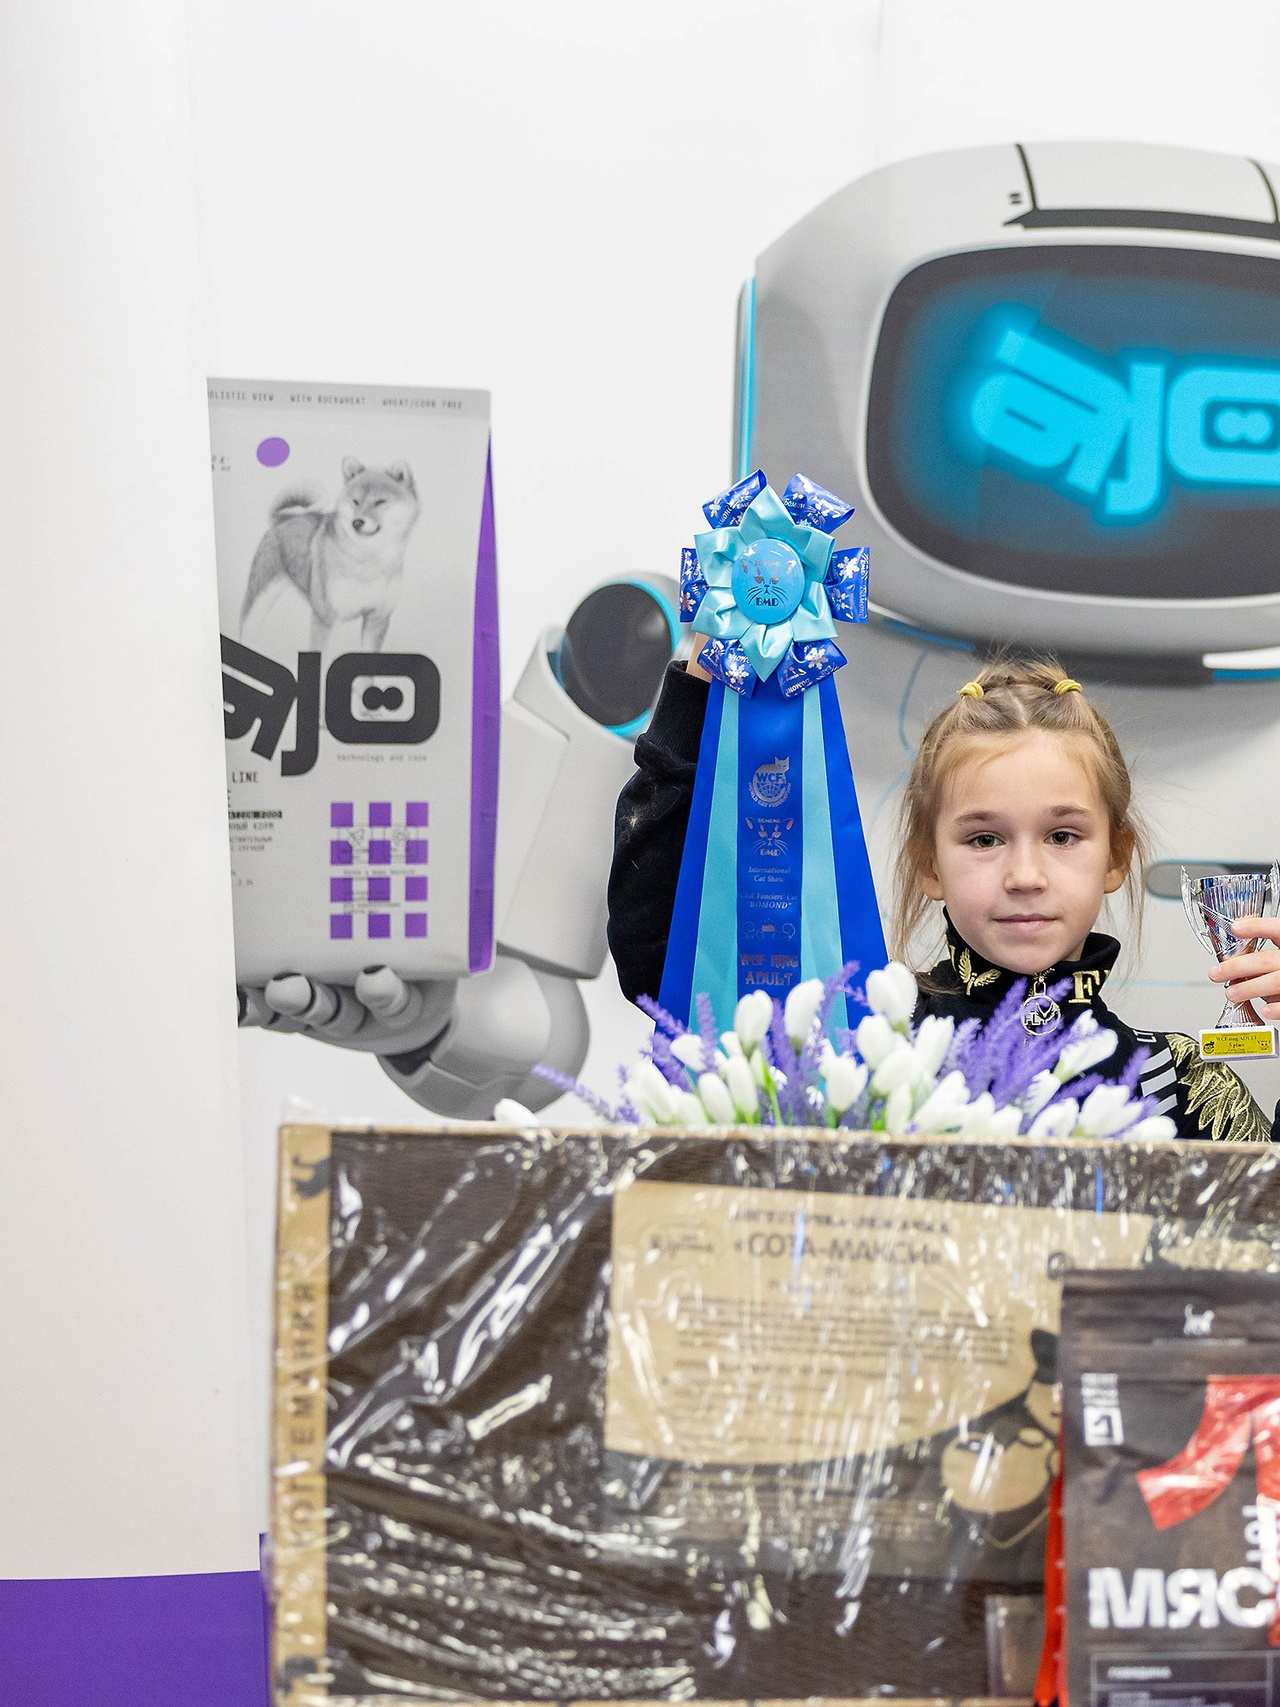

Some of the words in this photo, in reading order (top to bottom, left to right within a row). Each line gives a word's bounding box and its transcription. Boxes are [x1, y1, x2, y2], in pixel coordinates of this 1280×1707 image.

[755, 596, 780, 607] BMD
[232, 771, 258, 784] LINE
[756, 772, 785, 783] WCF
[753, 874, 766, 882] Cat
[745, 970, 794, 987] ADULT
